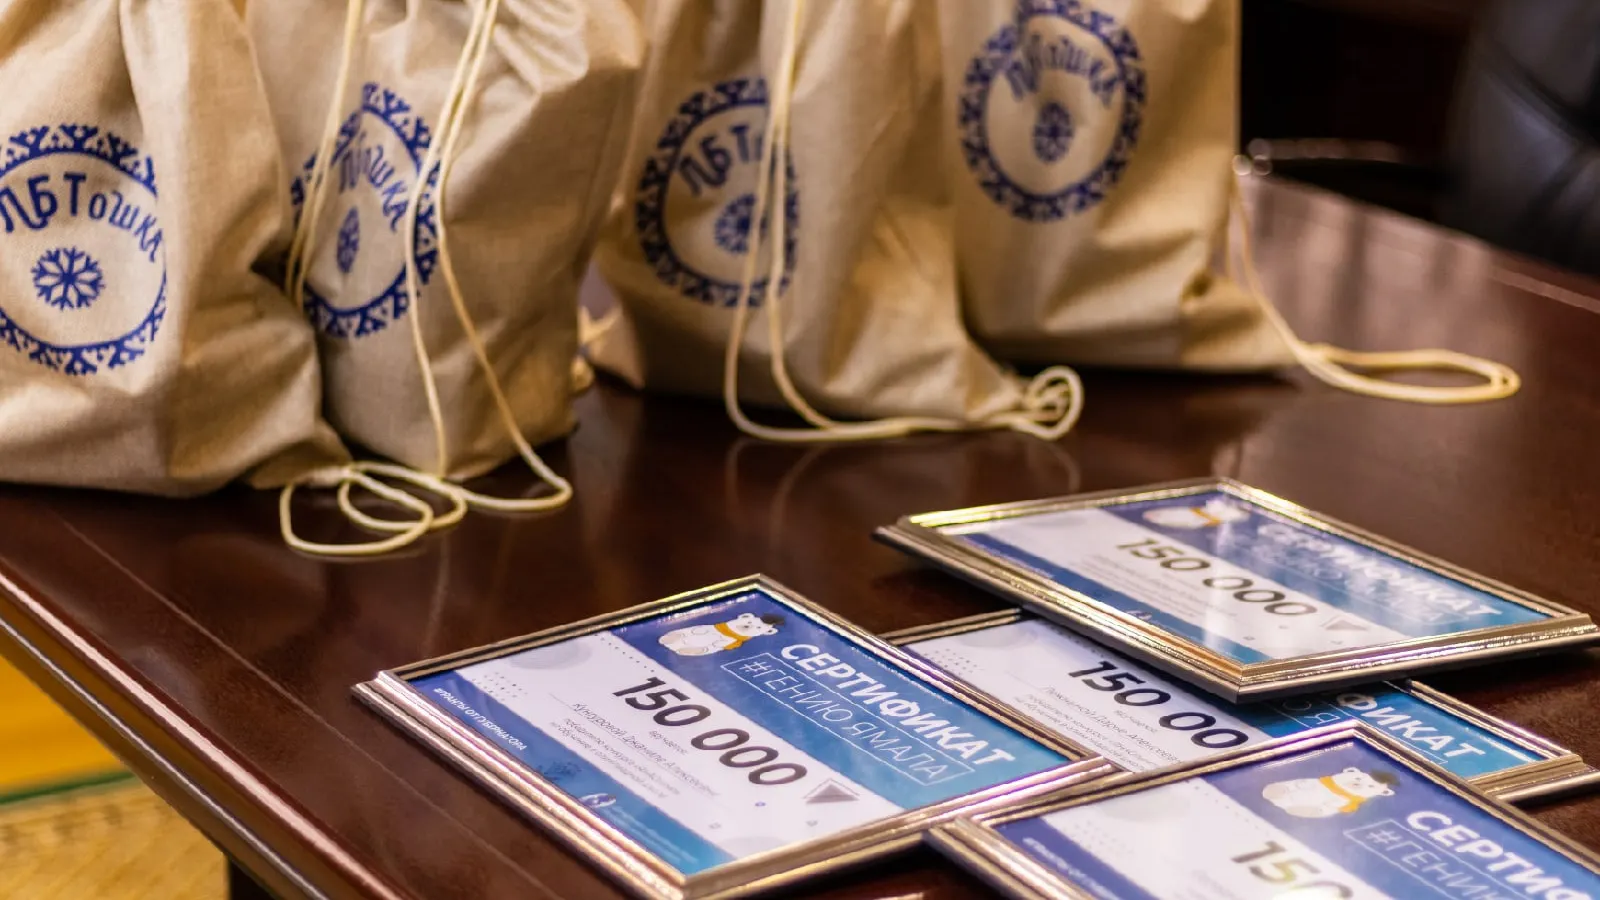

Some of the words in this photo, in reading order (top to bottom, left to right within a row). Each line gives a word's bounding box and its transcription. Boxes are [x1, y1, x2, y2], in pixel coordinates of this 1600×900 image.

[1116, 537, 1211, 571] 150
[1202, 576, 1318, 616] 000
[612, 676, 711, 726] 150
[691, 728, 808, 785] 000
[739, 661, 853, 722] #ГЕНИЮ
[842, 721, 949, 779] ЯМАЛА
[780, 643, 1016, 765] СЕРТИФИКАТ
[1068, 660, 1171, 707] 150
[1158, 711, 1249, 749] 00
